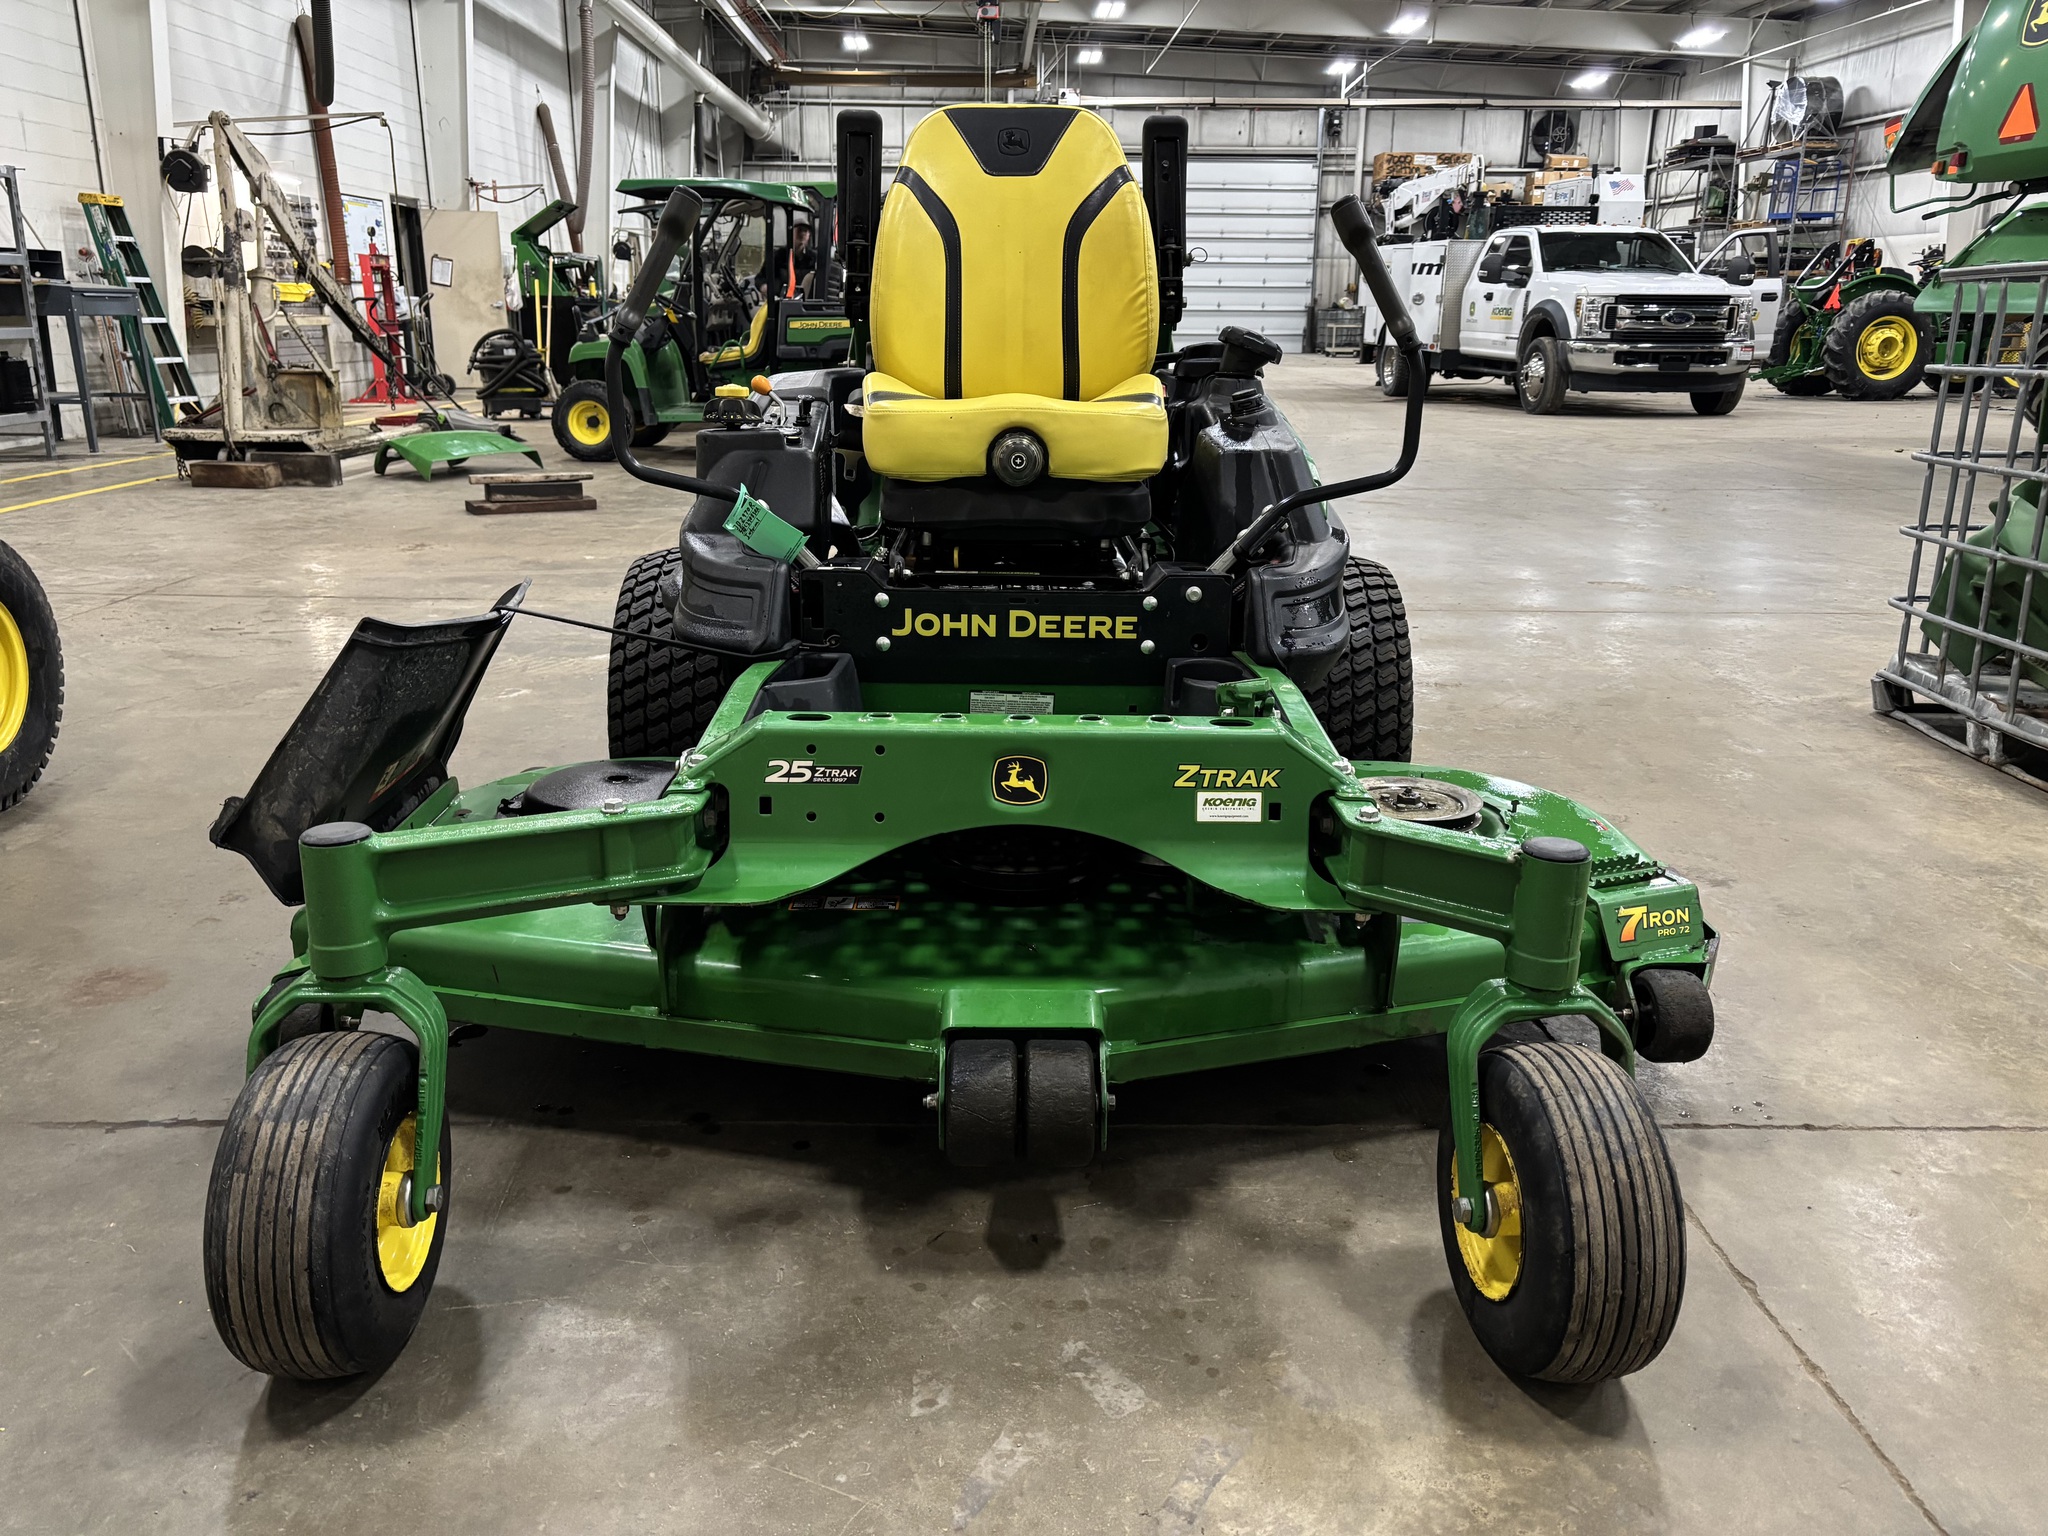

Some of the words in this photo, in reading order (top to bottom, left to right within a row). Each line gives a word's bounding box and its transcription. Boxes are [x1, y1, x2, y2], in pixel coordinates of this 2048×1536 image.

[892, 608, 997, 638] JOHN
[1009, 609, 1138, 639] DEERE
[765, 760, 814, 783] 25
[814, 767, 858, 778] ZTRAK
[1173, 764, 1283, 788] ZTRAK
[1657, 928, 1676, 937] PRO
[1679, 925, 1690, 934] 72
